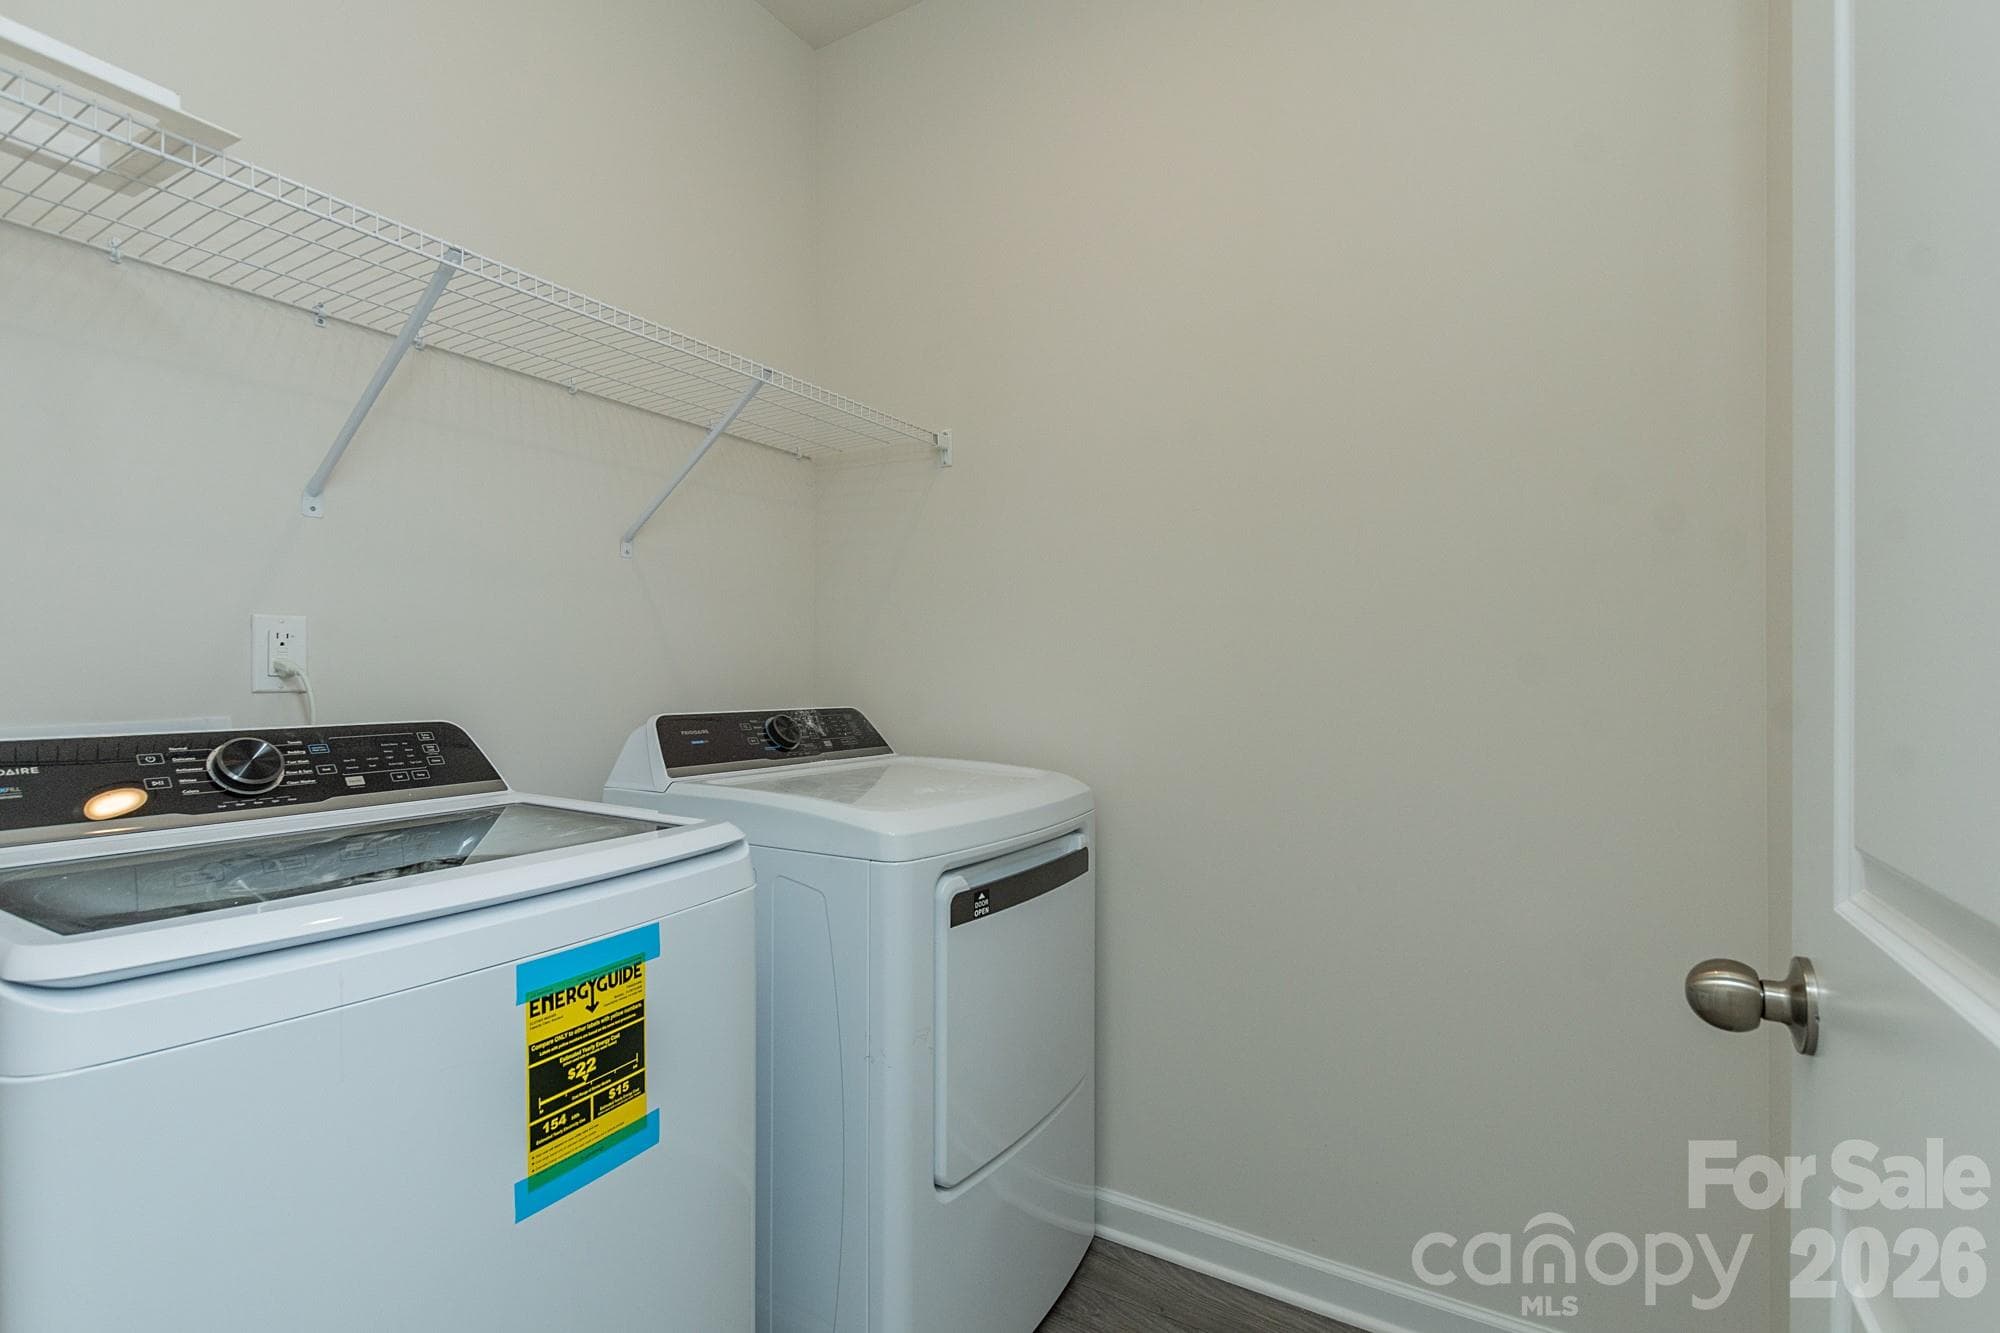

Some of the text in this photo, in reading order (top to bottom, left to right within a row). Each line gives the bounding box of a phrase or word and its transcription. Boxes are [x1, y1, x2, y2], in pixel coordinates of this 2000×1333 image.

[974, 898, 989, 909] DOOR
[974, 906, 990, 918] OPEN
[530, 961, 642, 1018] ENERGYGUIDE
[531, 1038, 553, 1052] Compare
[554, 1033, 567, 1042] ONLY
[574, 1025, 585, 1034] other
[587, 1019, 599, 1029] labels
[610, 1010, 622, 1020] yellow
[559, 1049, 581, 1063] Estimated
[582, 1044, 594, 1053] Yearly
[596, 1037, 609, 1048] Energy
[568, 1056, 596, 1081] $22
[609, 1080, 628, 1100] $15
[542, 1113, 566, 1134] 154
